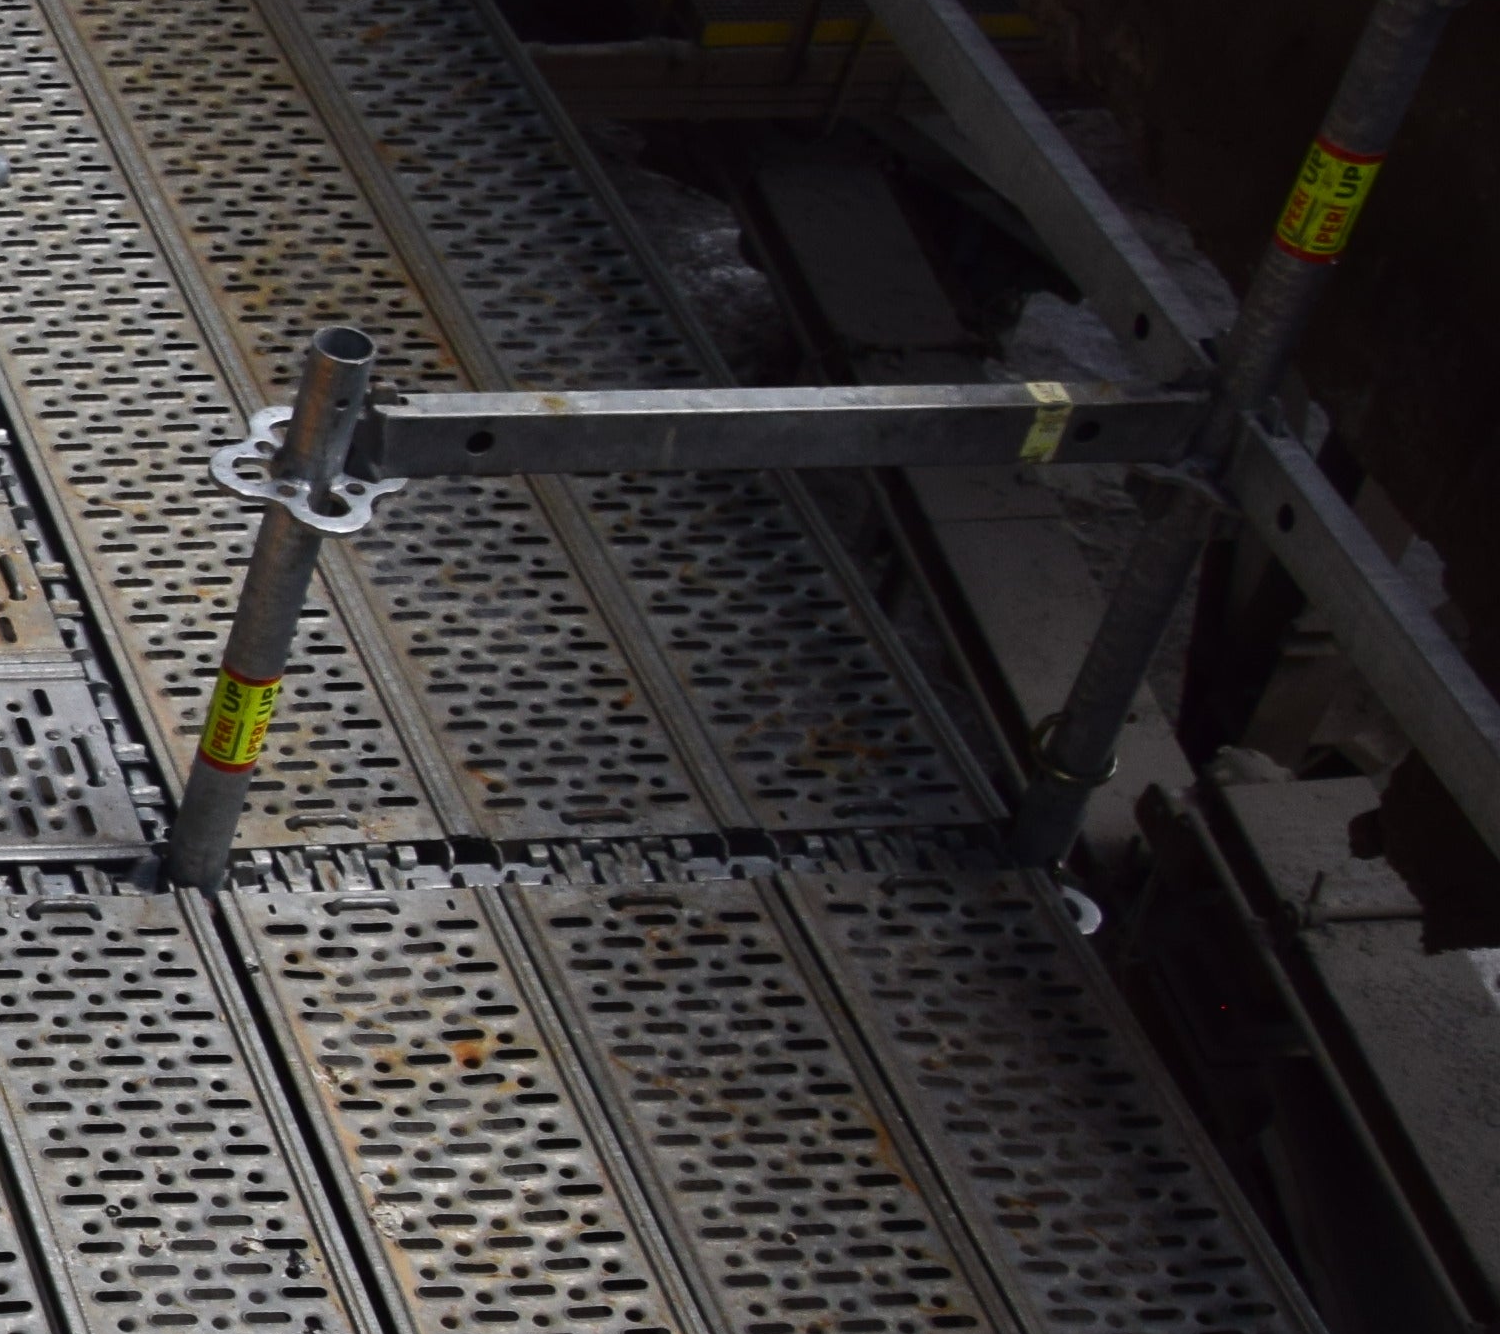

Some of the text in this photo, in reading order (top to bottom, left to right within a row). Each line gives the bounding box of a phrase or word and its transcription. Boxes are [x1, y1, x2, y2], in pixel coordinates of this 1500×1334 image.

[1283, 148, 1328, 230] PERI UP
[1314, 166, 1362, 244] PERI UP
[210, 680, 242, 754] PERI UP
[246, 687, 274, 754] PERI UP
